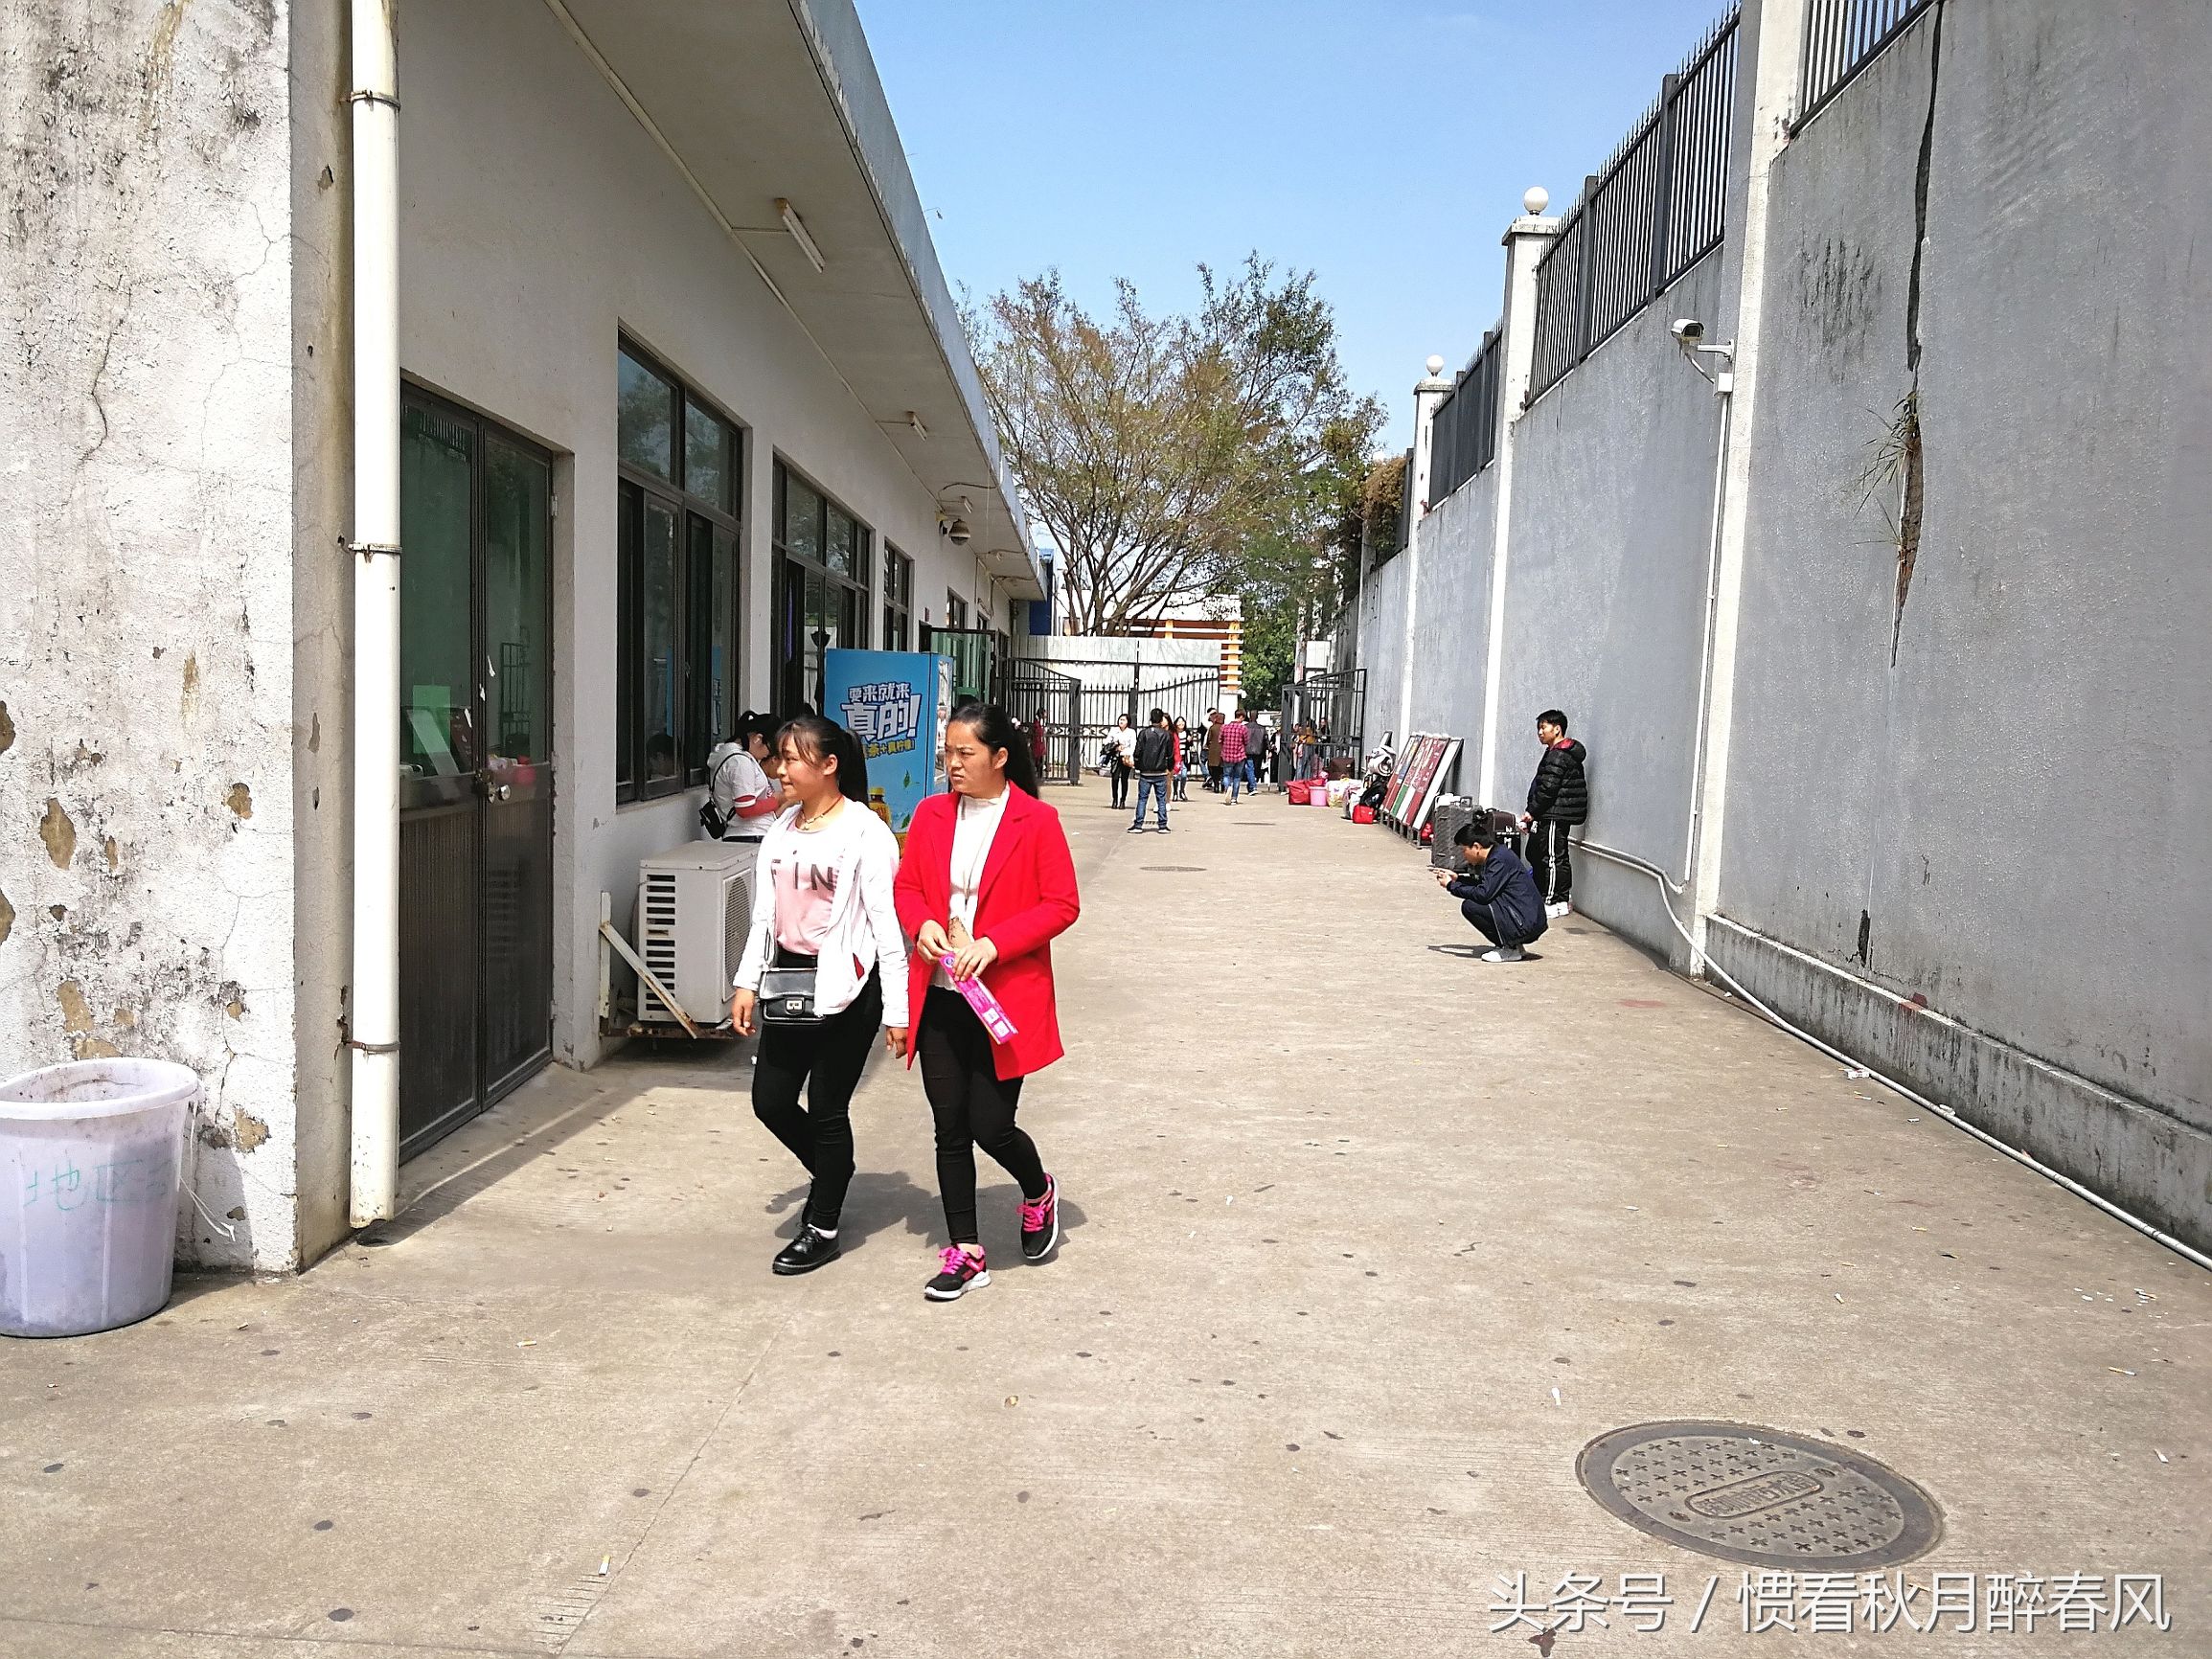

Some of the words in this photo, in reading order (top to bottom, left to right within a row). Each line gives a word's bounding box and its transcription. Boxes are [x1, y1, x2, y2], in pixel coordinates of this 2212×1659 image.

[848, 682, 910, 703] 要来就来
[840, 694, 923, 742] 真的!
